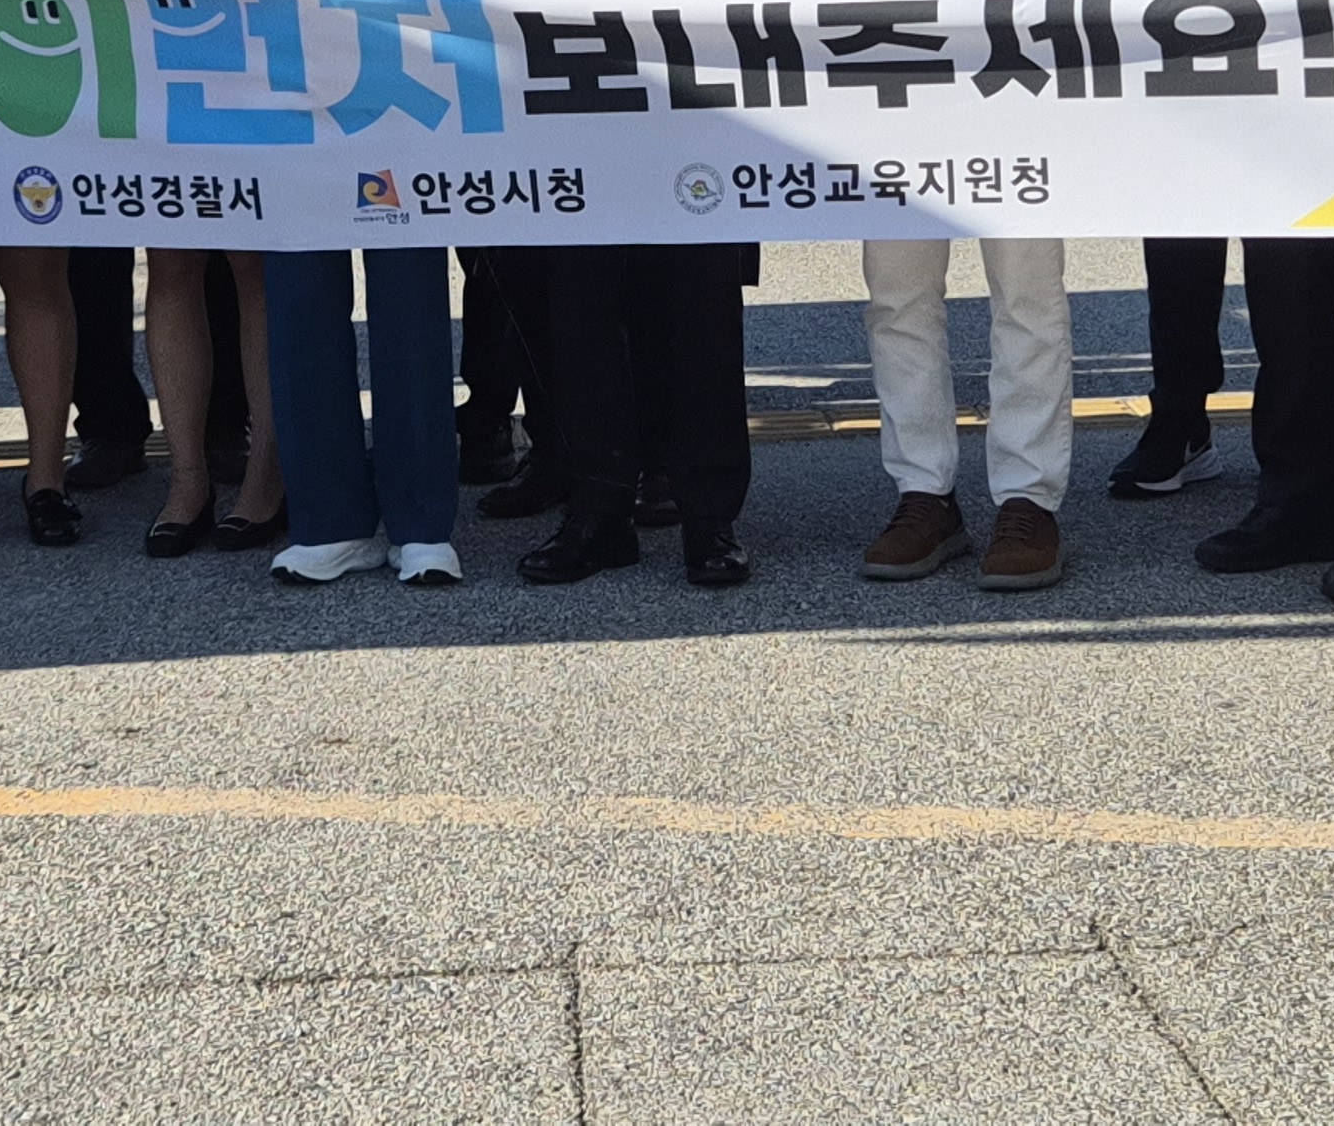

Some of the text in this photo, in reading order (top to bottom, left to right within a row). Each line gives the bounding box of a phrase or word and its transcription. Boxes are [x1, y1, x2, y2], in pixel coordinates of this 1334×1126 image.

[71, 173, 263, 221] 안성경찰서
[411, 167, 586, 215] 안성시청
[731, 156, 1051, 209] 안성교육지원청
